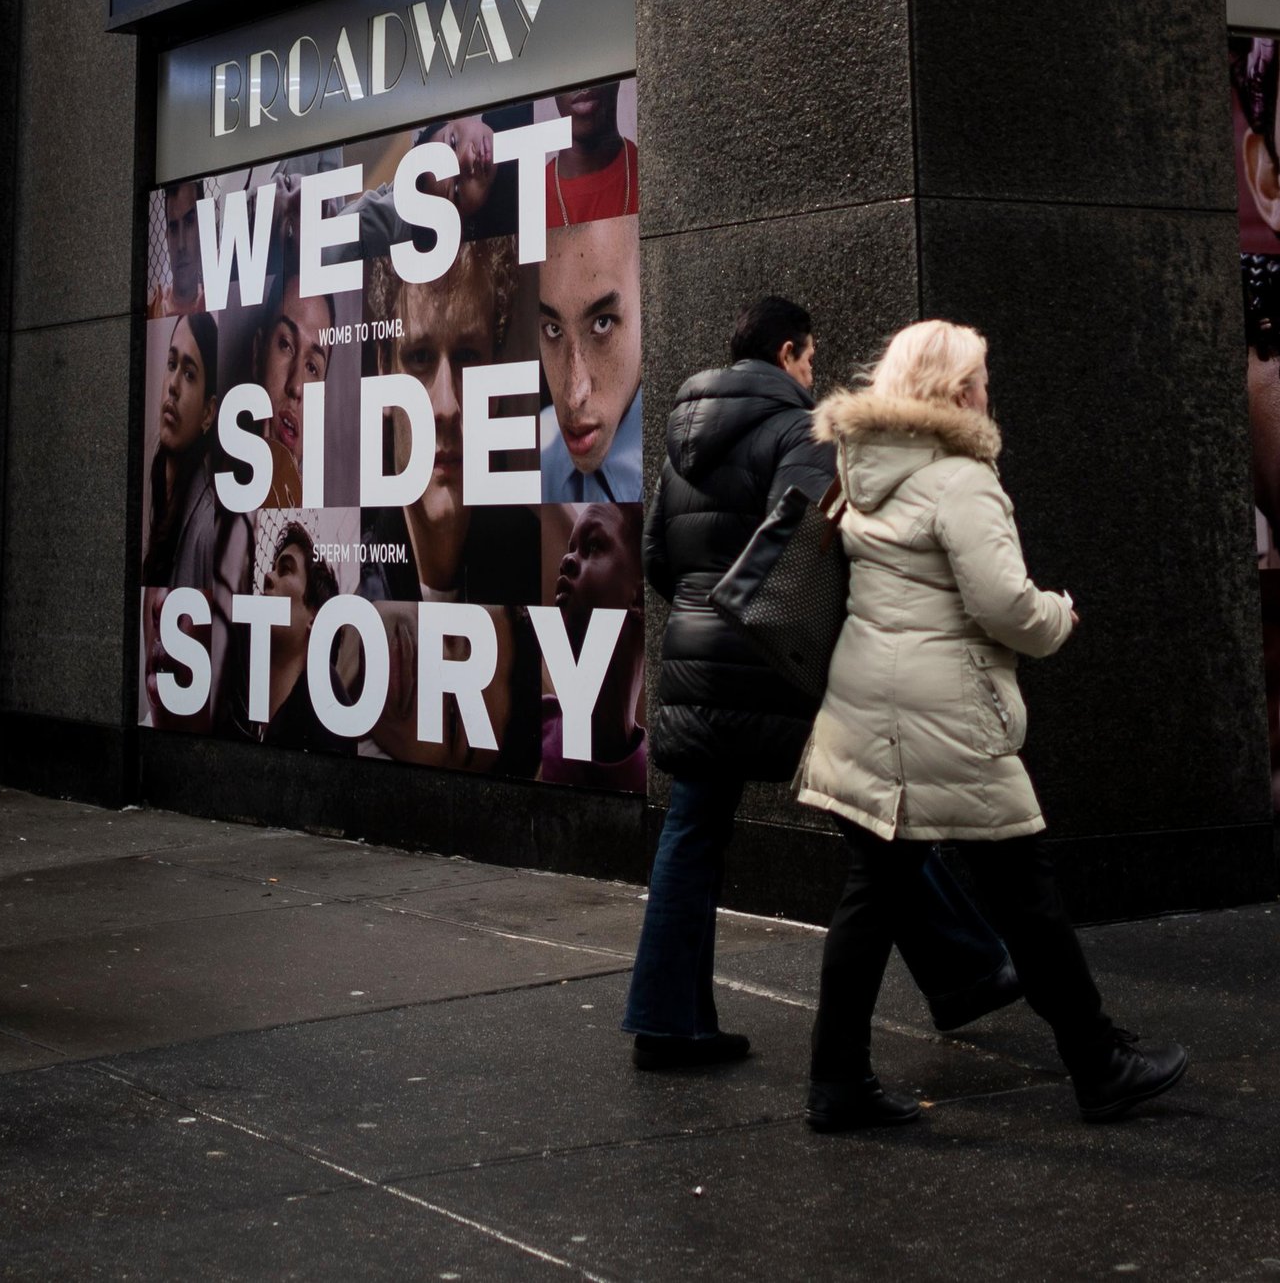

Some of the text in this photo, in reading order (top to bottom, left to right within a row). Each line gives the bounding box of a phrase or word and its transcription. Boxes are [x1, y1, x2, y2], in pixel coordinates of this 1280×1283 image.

[196, 117, 573, 311] WEST
[319, 318, 405, 346] WOMB TO TOMB.
[215, 360, 542, 514] SIDE
[312, 541, 408, 563] SPERM TO WORM.
[156, 586, 627, 761] STORY
